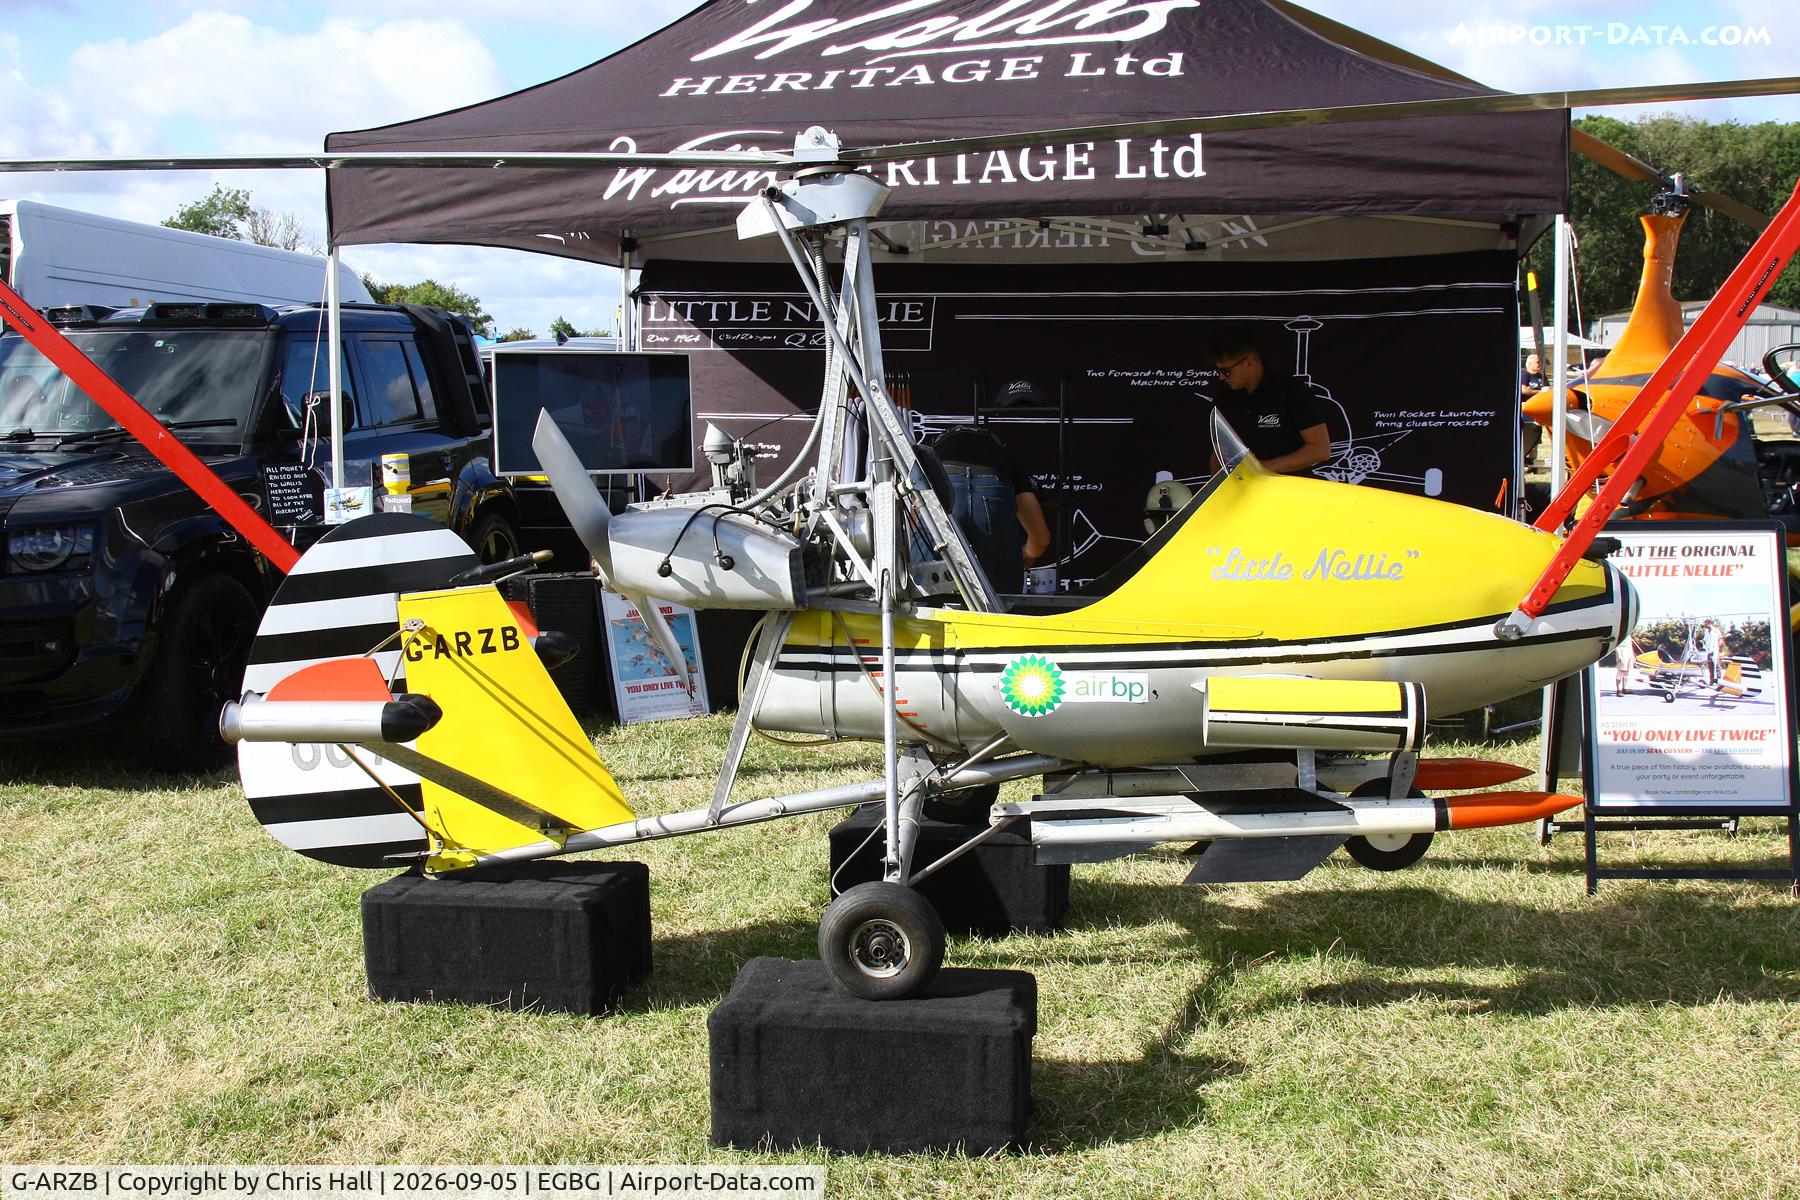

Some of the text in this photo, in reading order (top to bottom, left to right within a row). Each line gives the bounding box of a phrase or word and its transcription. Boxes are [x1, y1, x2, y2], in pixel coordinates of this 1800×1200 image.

[659, 52, 1185, 97] HERITAGE Ltd
[856, 141, 1095, 187] RITAGE
[1114, 132, 1207, 179] Ltd
[648, 300, 926, 323] LITTLE NIE
[1086, 369, 1106, 377] Two
[1186, 369, 1220, 379] Synch
[1178, 378, 1209, 386] Guns
[1257, 414, 1280, 425] Wallis
[1398, 410, 1437, 418] Rocket
[1440, 410, 1497, 418] Launchers
[1405, 420, 1446, 428] cluster
[1447, 420, 1490, 428] rockets
[266, 466, 278, 474] ALL
[1649, 545, 1678, 558] THE
[1681, 544, 1756, 557] ORIGINAL
[405, 625, 520, 662] G-ARZB
[625, 684, 642, 694] YOU
[643, 682, 661, 693] ONLY
[660, 680, 675, 690] LIVE
[1075, 676, 1144, 702] air bp
[1645, 729, 1683, 741] ONLY
[1685, 729, 1717, 741] LIVE
